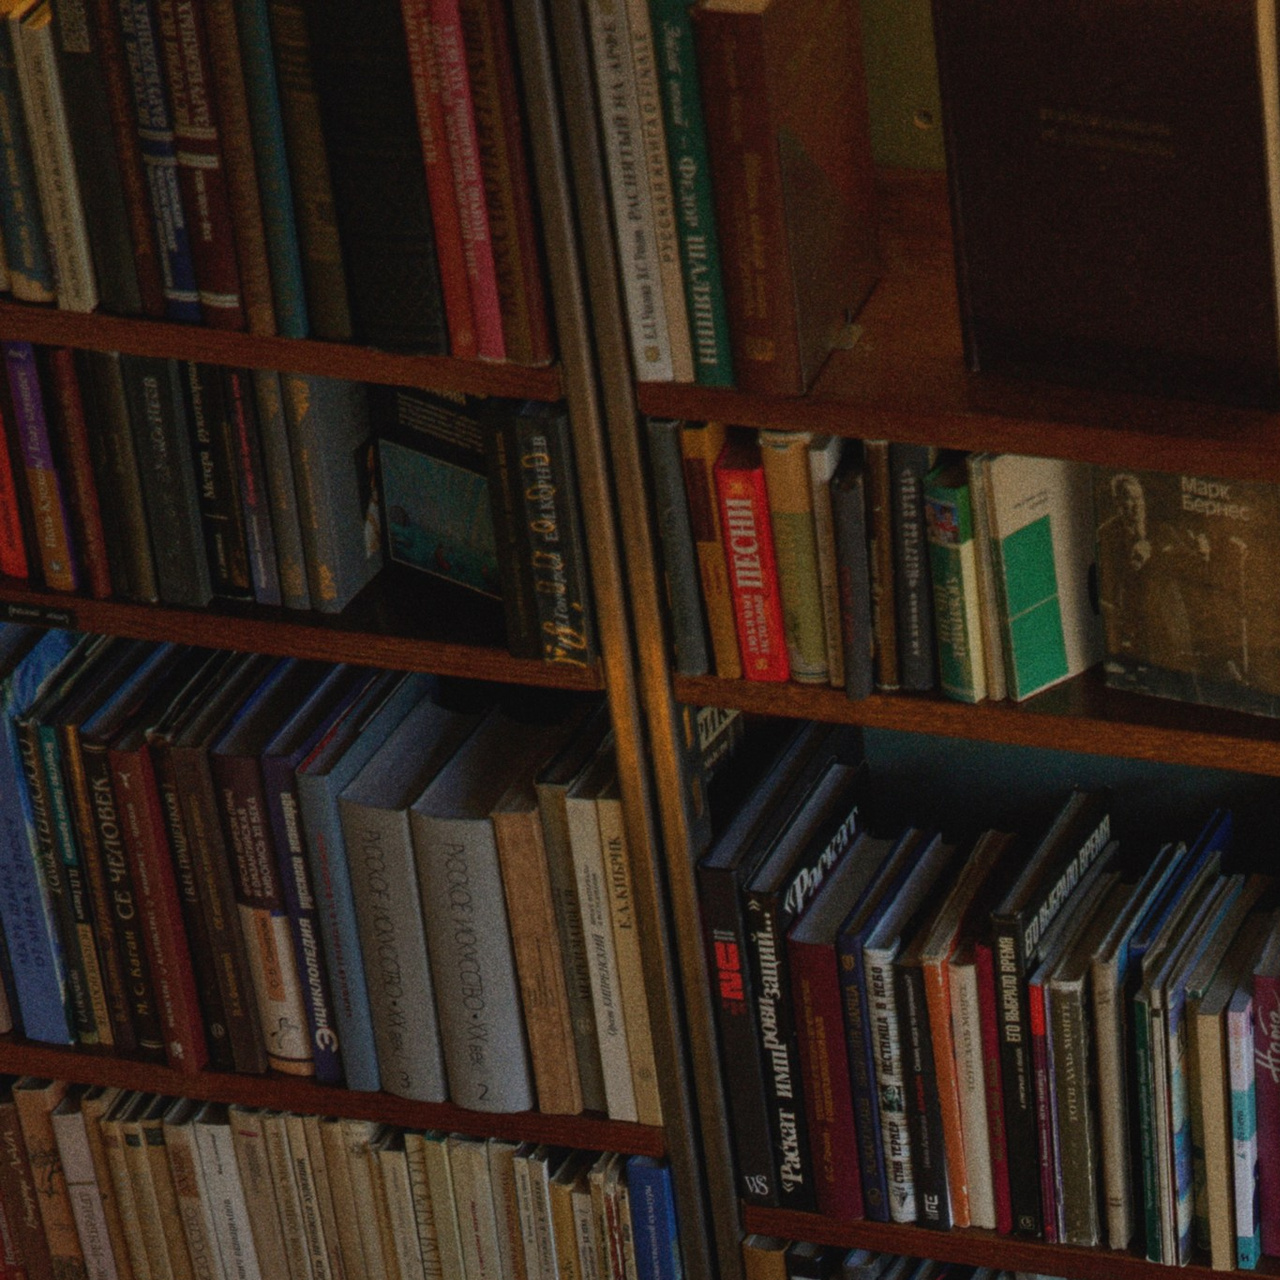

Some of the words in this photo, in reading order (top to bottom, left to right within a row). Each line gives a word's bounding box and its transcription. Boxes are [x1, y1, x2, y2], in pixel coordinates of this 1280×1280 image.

[598, 20, 624, 75] АРФЕ
[606, 79, 628, 109] НА
[646, 118, 664, 179] КНИГА
[653, 180, 674, 263] РУССКАЯ
[685, 232, 717, 366] ШАЛЯПИН
[1178, 472, 1233, 504] Марк
[1178, 489, 1253, 528] Бернес
[720, 493, 767, 592] ПЕСНИ
[783, 805, 860, 917] «Раскат
[112, 887, 135, 921] СЕ
[122, 928, 143, 979] Каган
[997, 934, 1017, 974] ВРЕМЯ
[868, 963, 885, 998] НЕБО
[1000, 974, 1020, 1023] ВЫБРАЛО
[874, 1015, 894, 1077] ЛЕСТНИЦА
[1003, 1023, 1022, 1043] ЕГО
[771, 1105, 806, 1193] «Раскат
